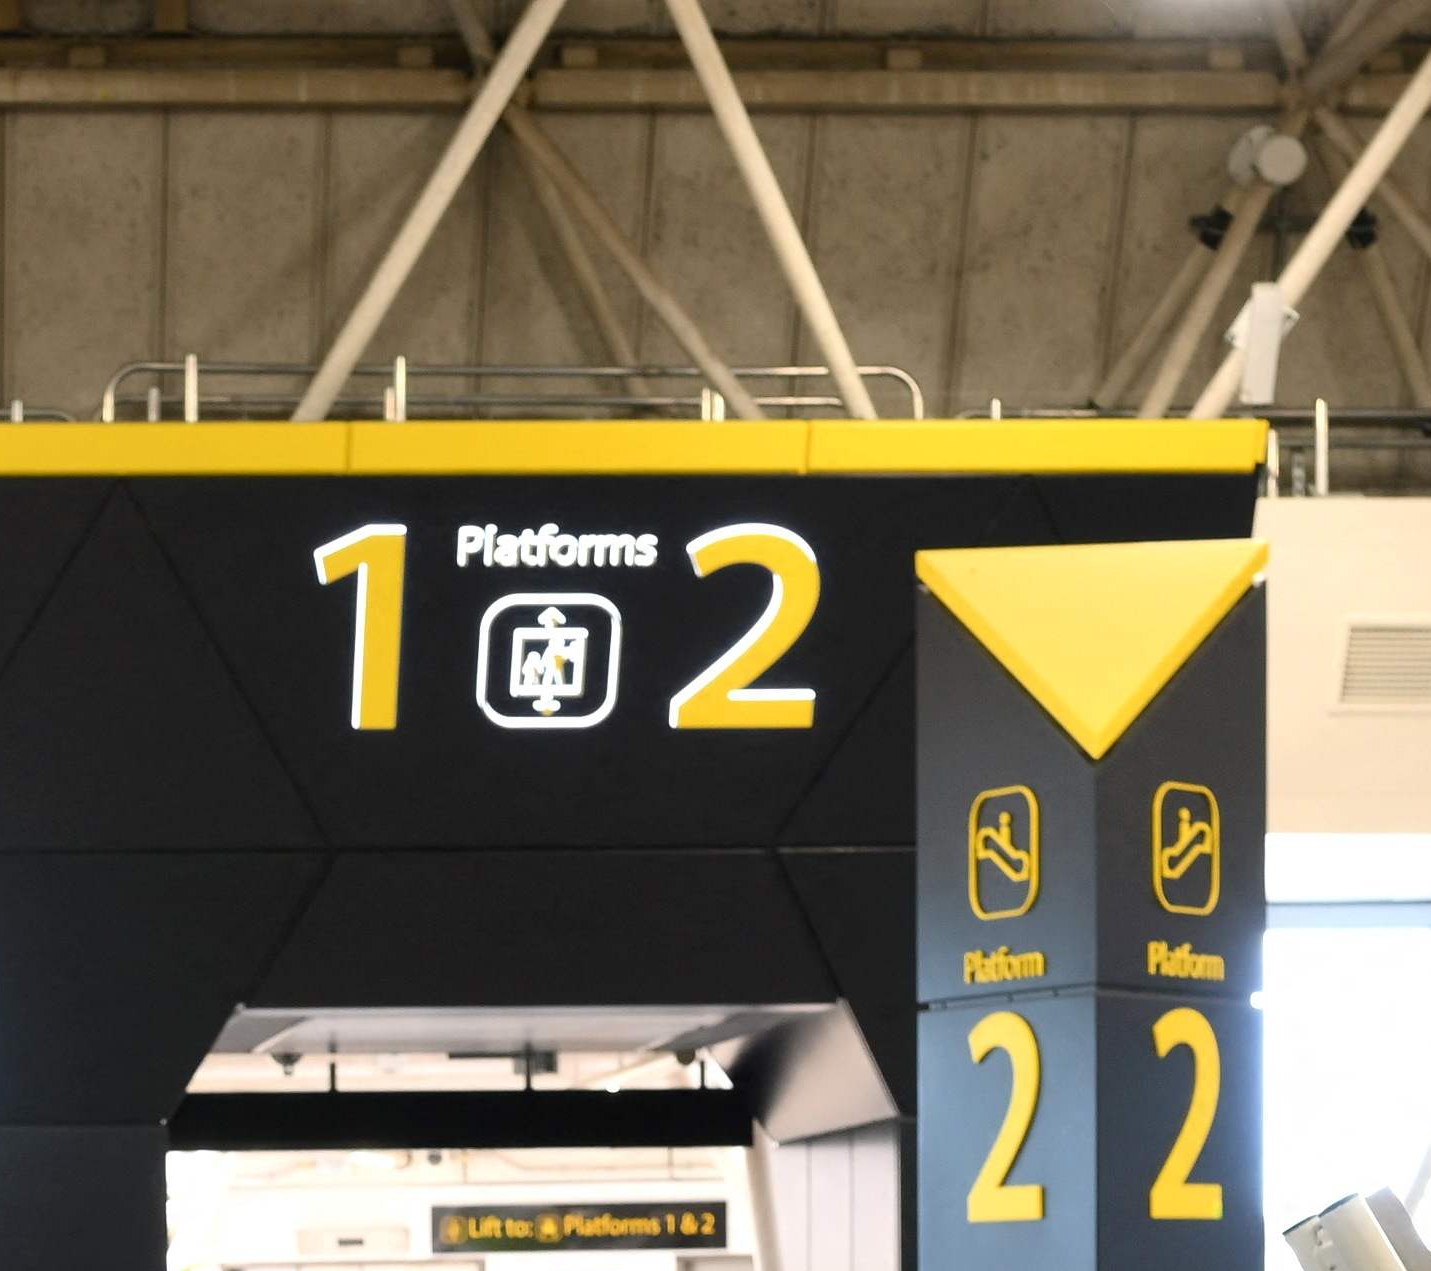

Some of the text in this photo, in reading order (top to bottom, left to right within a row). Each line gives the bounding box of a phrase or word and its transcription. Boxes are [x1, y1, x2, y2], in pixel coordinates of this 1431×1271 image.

[456, 523, 658, 567] Platforms
[313, 523, 407, 730] 1
[668, 522, 821, 729] 2
[964, 946, 1046, 984] Platform
[1147, 941, 1225, 981] Platform
[967, 1011, 1045, 1223] 2
[1149, 1007, 1223, 1220] 2
[468, 1215, 502, 1239] Lift
[564, 1212, 661, 1237] Platforms
[665, 1213, 676, 1234] 1
[680, 1211, 699, 1236] &
[701, 1212, 717, 1236] 2
